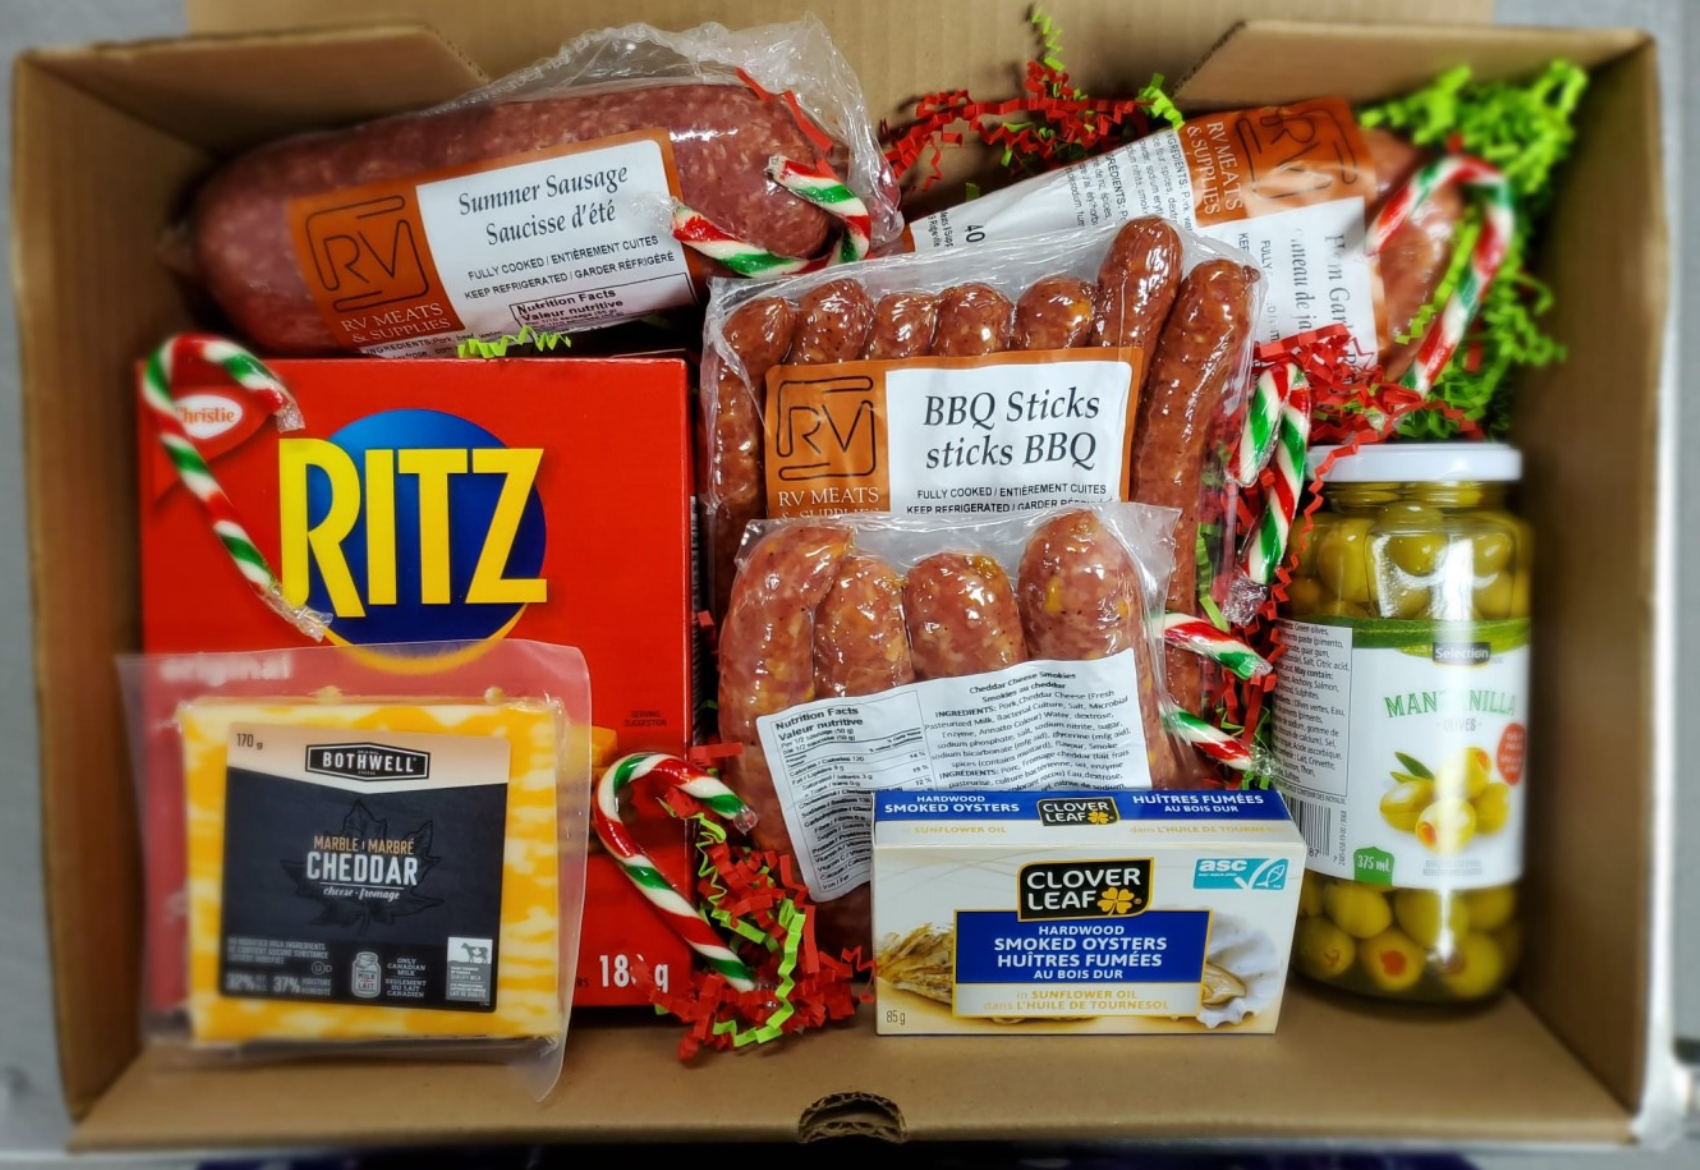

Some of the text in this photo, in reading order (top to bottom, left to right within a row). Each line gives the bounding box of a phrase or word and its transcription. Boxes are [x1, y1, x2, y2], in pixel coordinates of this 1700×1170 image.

[1206, 121, 1229, 144] RV
[1186, 125, 1222, 216] & SUPPLIES
[1213, 144, 1244, 212] MEATS
[458, 166, 629, 216] Summer Sausage
[486, 199, 617, 246] Saucisse d'été
[964, 224, 986, 243] 40
[468, 265, 500, 281] FULLY
[501, 257, 545, 276] COOKED
[551, 242, 620, 265] ENTIÈREMENT
[622, 235, 660, 251] CUITES
[1260, 239, 1273, 270] FULLY
[464, 288, 491, 301] KEEP
[492, 273, 569, 295] REFRIGERATED
[574, 263, 617, 280] GARDER
[618, 251, 676, 271] RÉFRIGÉRÉ
[516, 288, 618, 316] Nutrition Facts
[521, 299, 625, 323] Valeur nutritive
[341, 302, 444, 333] RV MEATS
[352, 317, 452, 344] & SUPPLIES
[923, 386, 1101, 430] BBQ Sticks
[925, 430, 1098, 471] sticks BBQ
[778, 486, 879, 507] RV MEATS
[917, 489, 948, 500] FULLY
[950, 487, 993, 498] COOKED
[1000, 482, 1068, 498] ENTIÈREMENT
[1071, 483, 1107, 495] CUITES
[907, 505, 933, 514] KEEP
[935, 502, 1010, 514] REFRIGERATED
[278, 438, 548, 619] RITZ
[969, 681, 1006, 695] Cheddar
[1007, 673, 1038, 687] Cheese
[935, 705, 997, 719] INGREDIENTS:
[1382, 689, 1517, 719] MANNILLA
[624, 719, 667, 727] SUGGESTION
[631, 711, 661, 719] SERVING
[775, 707, 860, 731] Nutrition Facts
[778, 718, 864, 741] Valeur nutritive
[236, 732, 264, 750] 170 g
[322, 751, 414, 773] BOTHWELL
[884, 803, 1021, 814] SMOKED OYSTERS
[916, 795, 986, 803] HARDWOOD
[1042, 801, 1110, 813] CLOVER
[1132, 793, 1264, 805] HUÎTRES FUMÉES
[1164, 805, 1239, 813] AU BOIS DUR
[1044, 812, 1087, 823] LEAF
[914, 826, 985, 834] SUNFLOWER
[988, 825, 1006, 834] OIL
[1202, 826, 1218, 834] DE
[313, 835, 415, 855] MARBLE MARBRÉ
[306, 851, 419, 886] CHEDDAR
[1198, 860, 1249, 873] asc
[1357, 854, 1375, 870] 375
[1026, 867, 1142, 890] CLOVER
[323, 886, 401, 903] cheese fromage
[1027, 890, 1097, 911] LEAF
[1038, 925, 1125, 936] HARDWOOD
[994, 936, 1168, 951] SMOKED OYSTERS
[387, 963, 427, 972] CANADIAN
[997, 948, 1163, 969] HUÎTRES FUMÉES
[599, 953, 643, 989] 18
[1033, 969, 1124, 979] AU BOIS DUR
[1016, 1000, 1065, 1010] L'HUILE
[1069, 1000, 1089, 1010] DE
[1091, 1000, 1170, 1010] TOURNESOL
[1031, 989, 1113, 1000] SUNFLOWER
[1116, 989, 1138, 999] OIL
